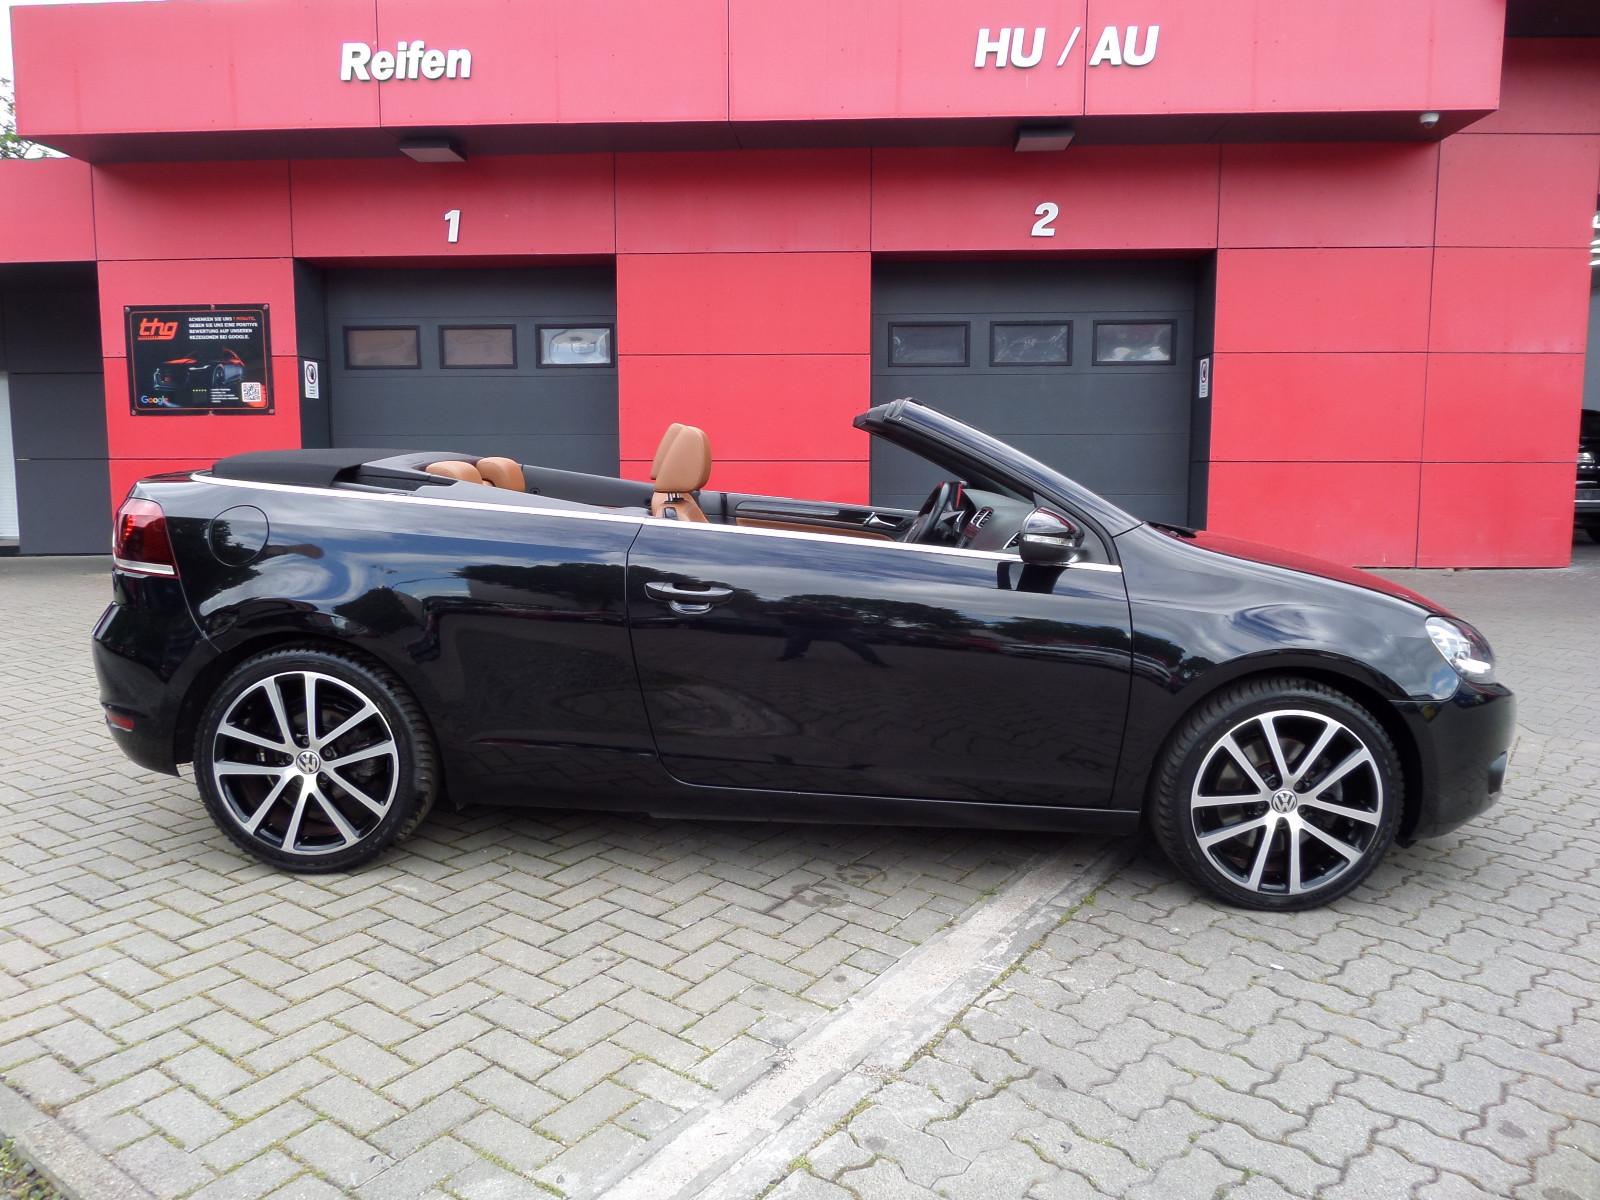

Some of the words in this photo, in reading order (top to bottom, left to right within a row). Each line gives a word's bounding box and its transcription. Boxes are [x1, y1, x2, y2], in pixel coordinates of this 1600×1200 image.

[340, 40, 472, 81] Reifen
[974, 27, 1046, 69] HU
[1056, 26, 1081, 67] /
[1088, 25, 1160, 67] AU
[444, 209, 461, 243] 1
[1031, 202, 1059, 237] 2
[139, 317, 178, 340] thg
[141, 395, 169, 406] Google
